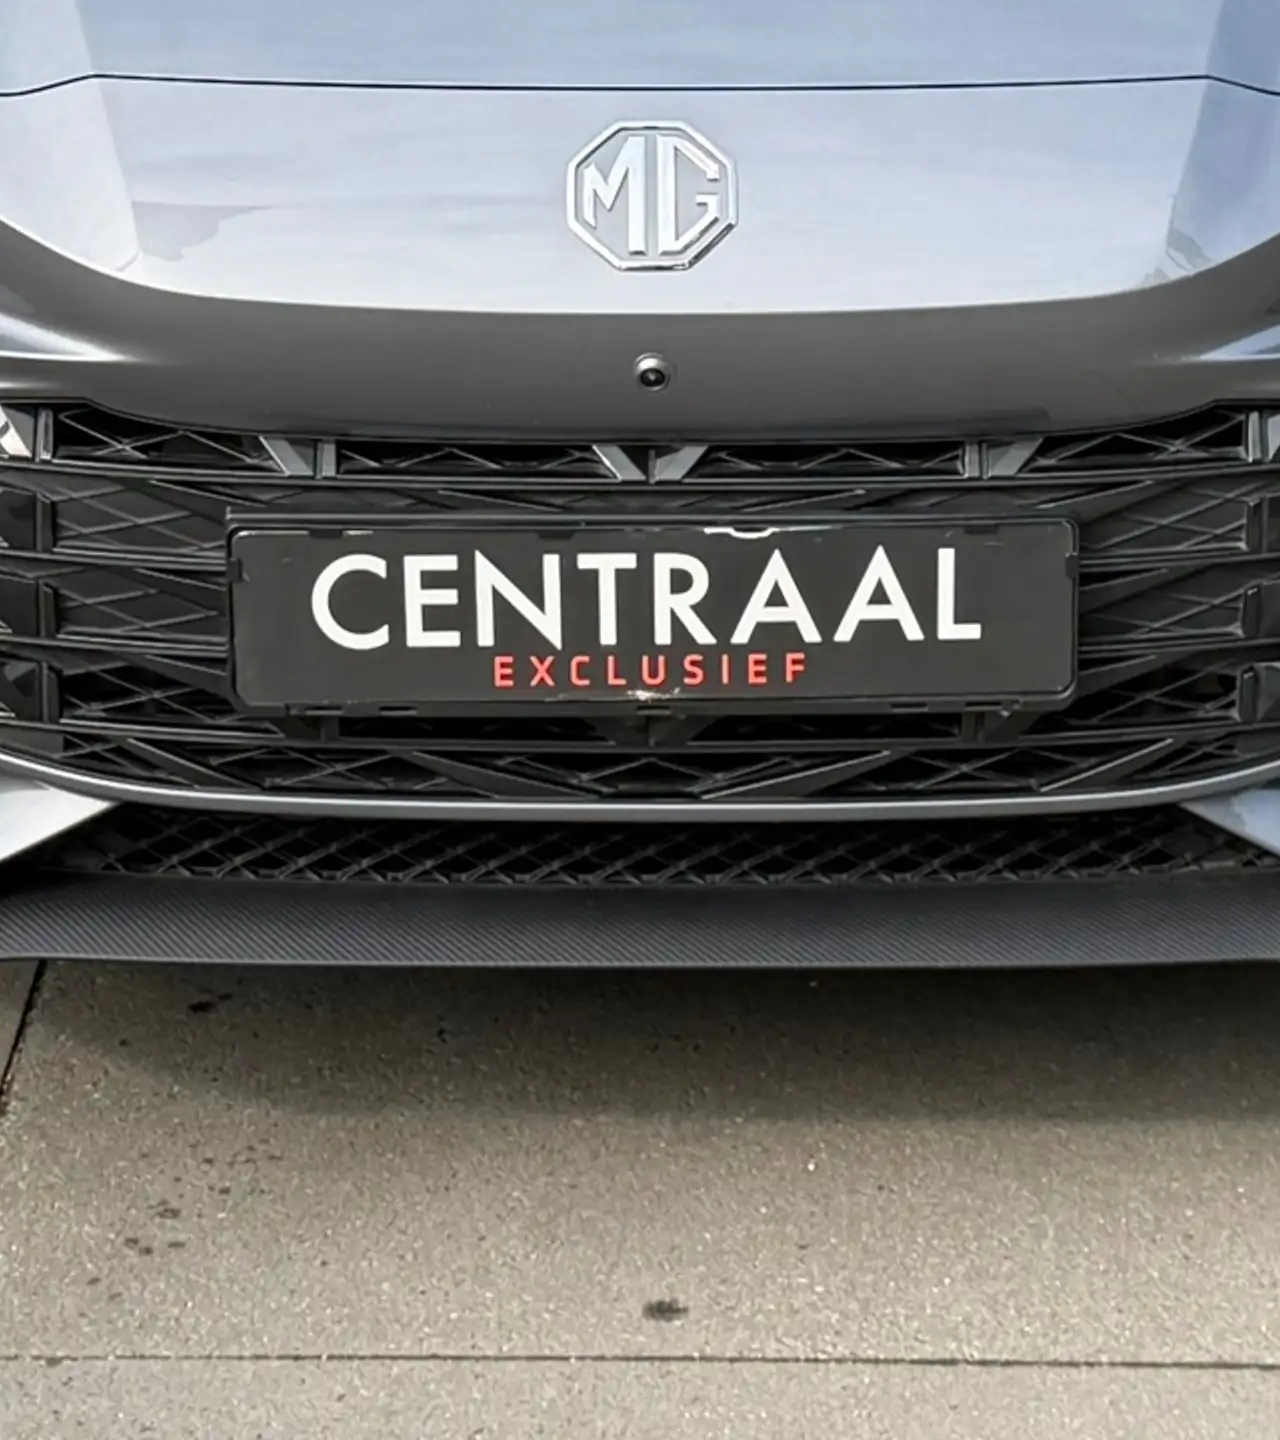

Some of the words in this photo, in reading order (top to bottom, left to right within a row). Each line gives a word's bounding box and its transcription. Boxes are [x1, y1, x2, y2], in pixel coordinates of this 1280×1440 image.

[582, 134, 721, 257] MG
[310, 545, 983, 651] CENTRAAL
[493, 652, 808, 689] EXCLUSIEF
